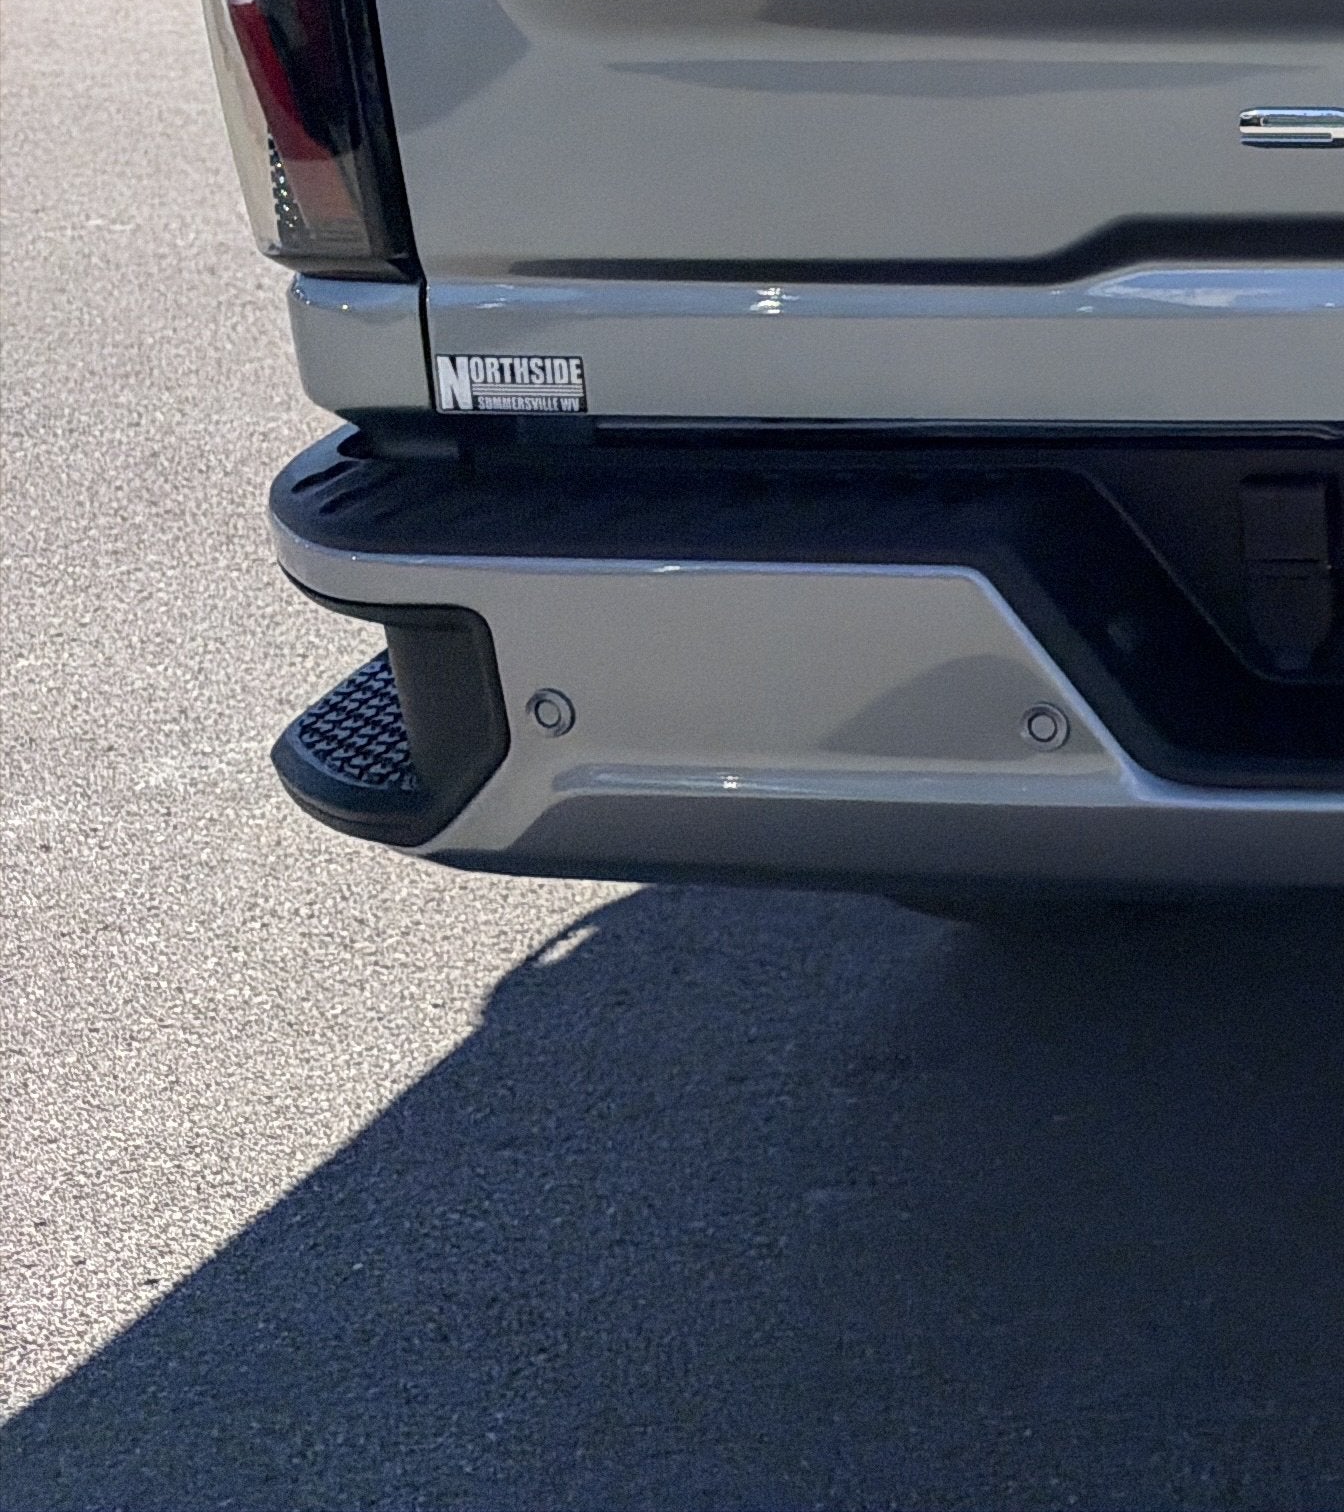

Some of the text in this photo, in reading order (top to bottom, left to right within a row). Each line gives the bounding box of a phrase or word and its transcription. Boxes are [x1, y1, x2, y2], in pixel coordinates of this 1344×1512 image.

[436, 355, 583, 410] NORTHSIDE
[477, 396, 580, 412] SUMMERSVILLE WV
